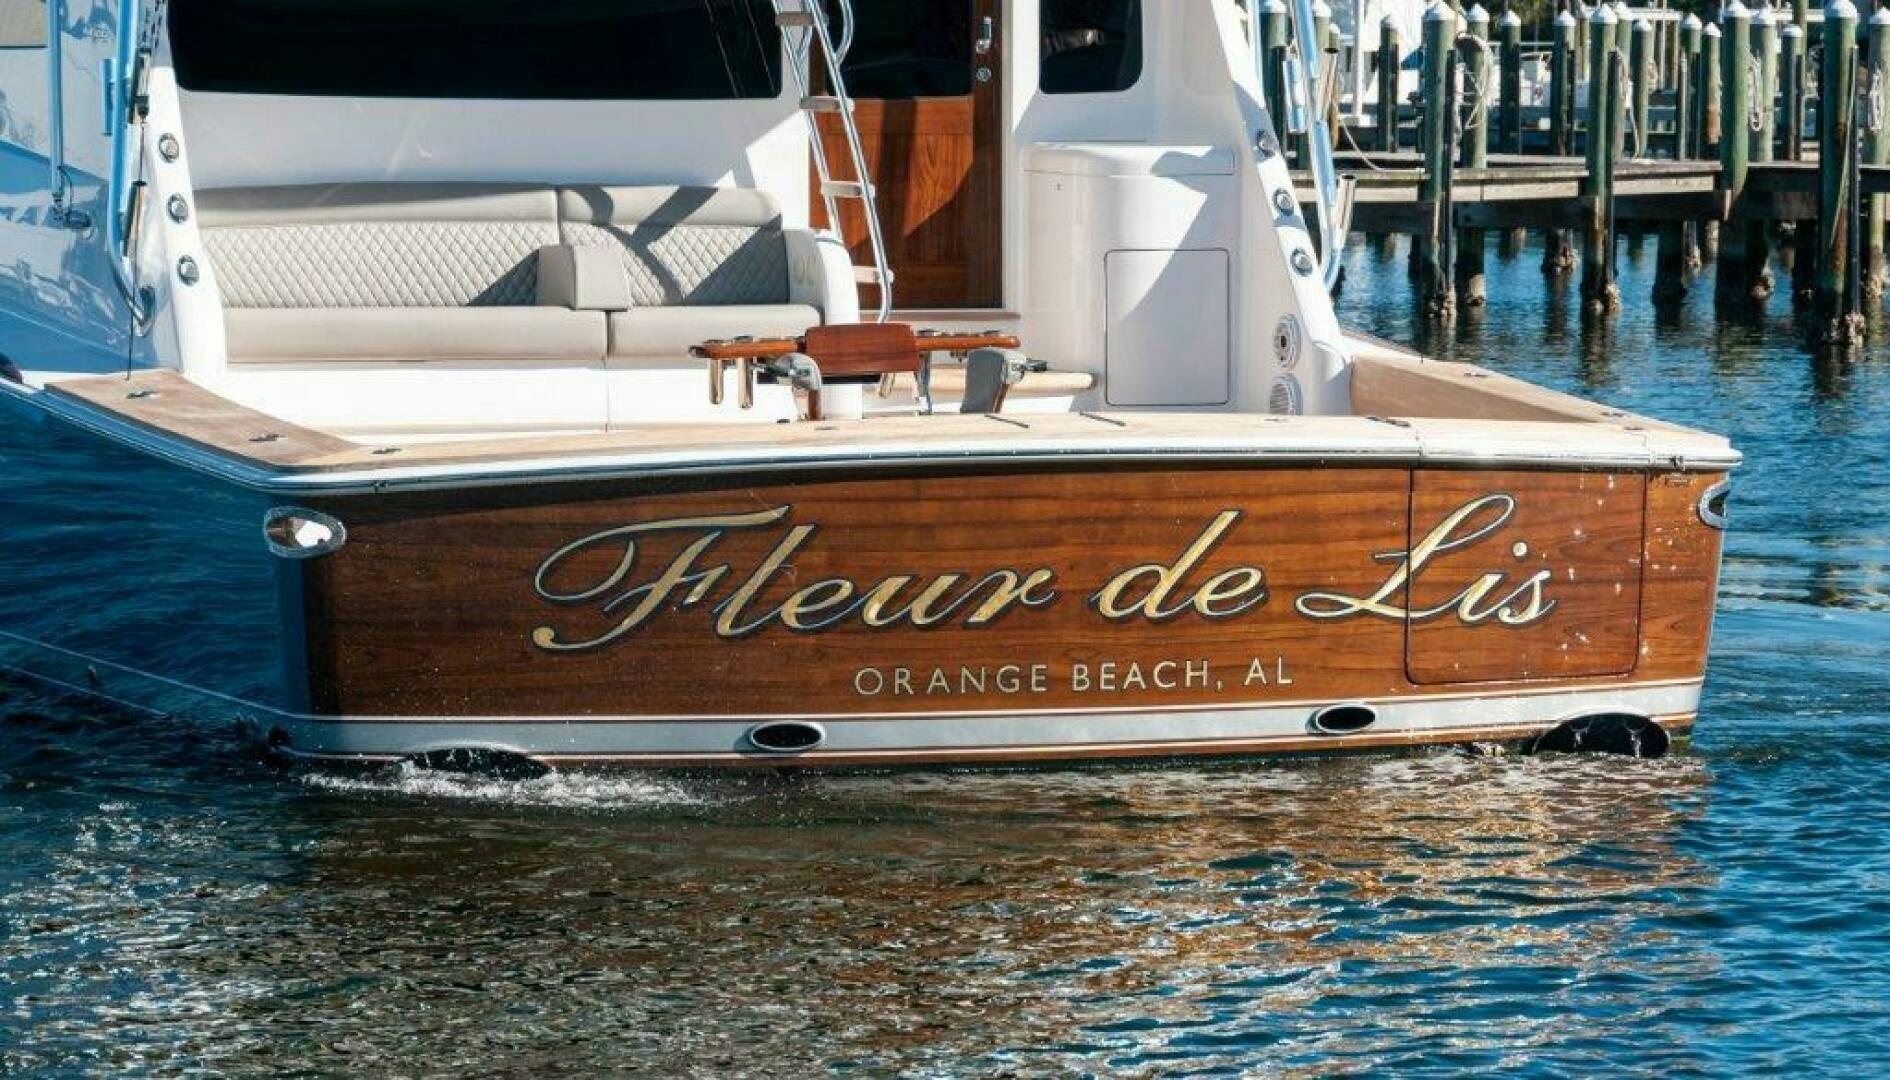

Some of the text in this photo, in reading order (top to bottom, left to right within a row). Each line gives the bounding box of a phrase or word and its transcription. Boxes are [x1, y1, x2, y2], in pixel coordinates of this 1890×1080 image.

[532, 493, 1556, 651] Fleur de Lis
[854, 656, 1294, 696] ORANGE BEACH, AL
